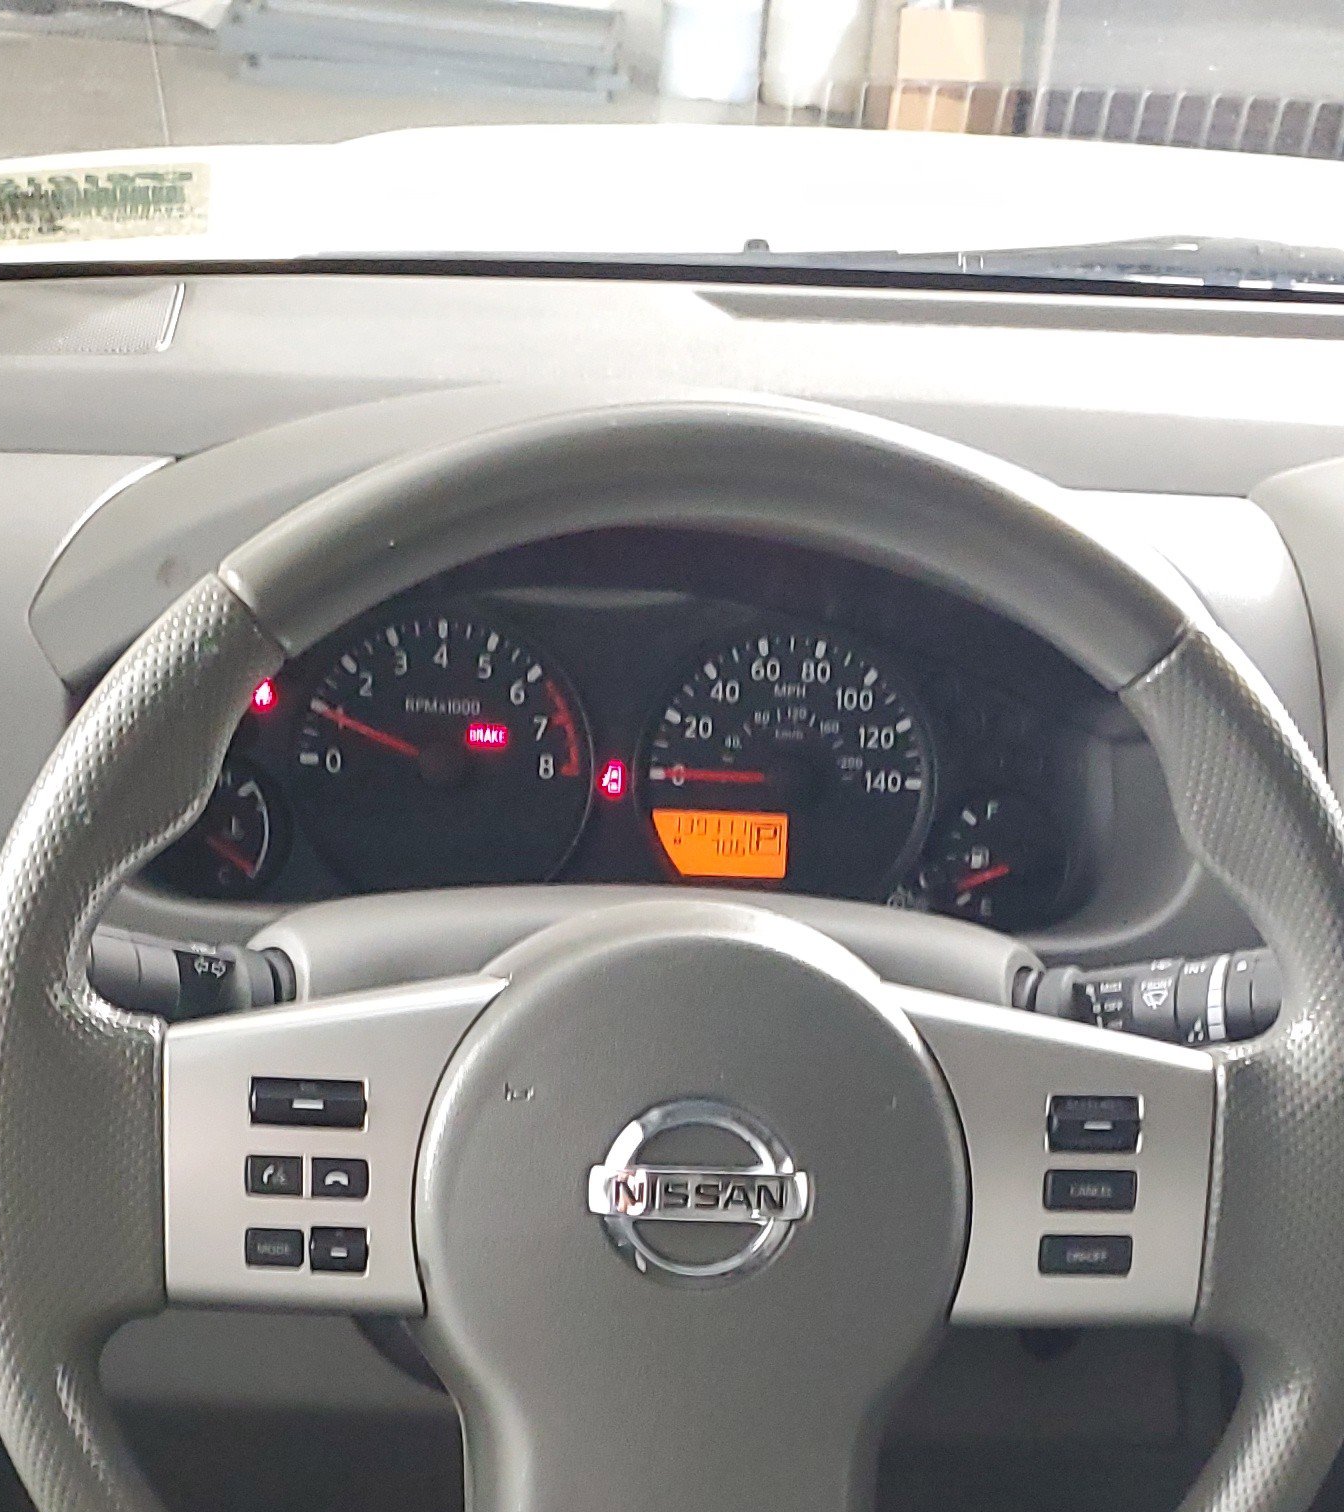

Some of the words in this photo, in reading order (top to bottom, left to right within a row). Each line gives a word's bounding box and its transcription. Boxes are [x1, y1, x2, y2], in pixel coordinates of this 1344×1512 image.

[393, 649, 408, 676] 3
[433, 643, 448, 669] 4
[477, 652, 493, 679] 5
[750, 656, 782, 682] 60
[358, 670, 374, 697] 2
[801, 658, 832, 684] 80
[509, 680, 526, 706] 6
[710, 679, 741, 703] 40
[773, 682, 807, 699] MPH
[835, 685, 874, 712] 100
[468, 727, 507, 746] BRAKE
[533, 714, 549, 743] 7
[683, 715, 714, 740] 20
[858, 725, 895, 751] 120
[325, 747, 342, 774] 0
[538, 752, 555, 780] 8
[864, 769, 902, 794] 140
[613, 1176, 786, 1212] NISSAN
